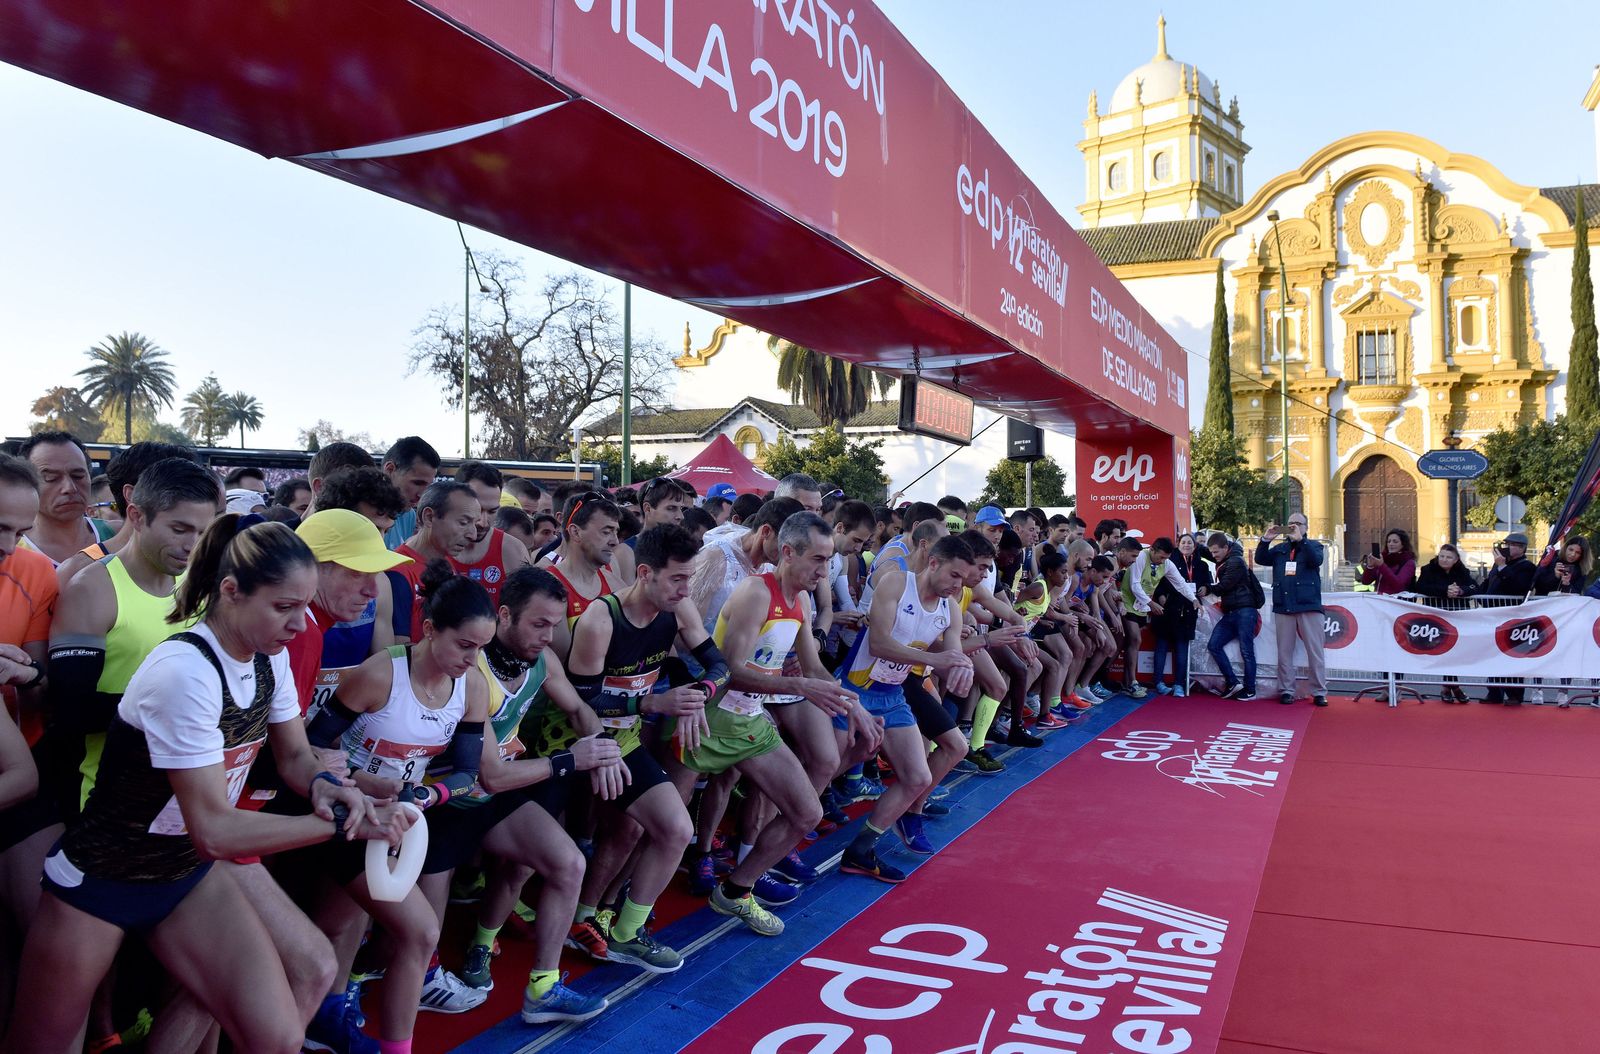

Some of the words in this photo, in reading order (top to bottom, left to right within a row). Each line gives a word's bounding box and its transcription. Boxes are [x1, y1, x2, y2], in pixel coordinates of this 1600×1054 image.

[750, 58, 847, 177] 2019
[957, 164, 1003, 250] edp
[1020, 222, 1061, 278] maratón
[1017, 304, 1044, 339] edición
[1091, 286, 1108, 327] EDP
[1109, 304, 1133, 349] MEDIO
[1134, 326, 1162, 372] MARATÓN
[1102, 346, 1115, 382] DE
[1115, 356, 1142, 397] SEVILLA
[1142, 375, 1157, 406] 2019
[1091, 446, 1156, 491] edp
[1100, 494, 1131, 502] energía
[1133, 493, 1159, 501] oficial
[1324, 617, 1340, 636] dp
[1409, 624, 1440, 642] edp
[1510, 625, 1540, 645] edp
[631, 677, 645, 688] edp
[234, 746, 253, 765] edp
[1097, 730, 1194, 762] edp
[1196, 731, 1253, 768] maratón
[402, 760, 415, 781] 8
[1108, 926, 1226, 1054] evilla
